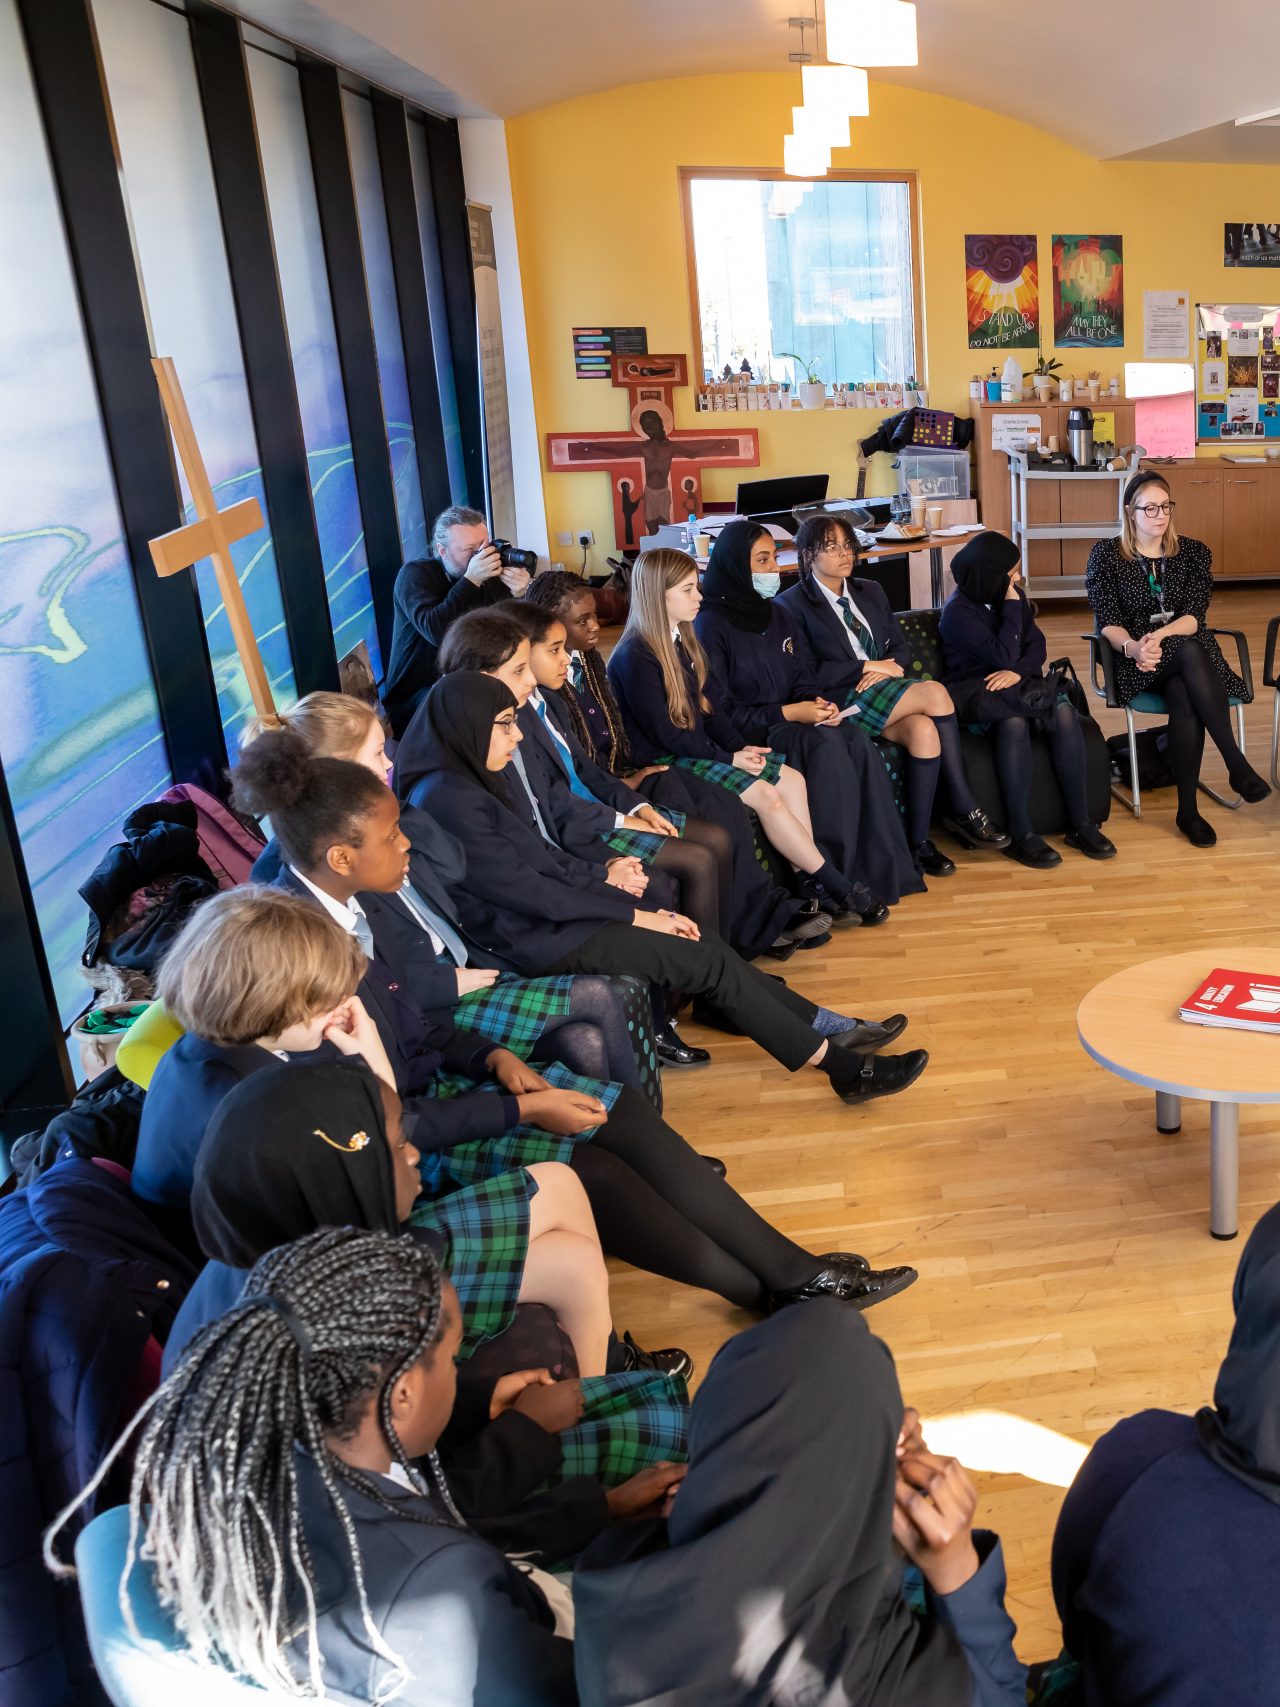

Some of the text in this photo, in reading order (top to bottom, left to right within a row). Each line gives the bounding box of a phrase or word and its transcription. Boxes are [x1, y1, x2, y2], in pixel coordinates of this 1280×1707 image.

[976, 308, 1030, 327] STAND UP
[1071, 315, 1109, 328] MAY THEY
[969, 321, 1035, 348] DO NOT BE AFRAID
[1065, 325, 1118, 340] ALL BE ONE
[1193, 1001, 1218, 1011] 4
